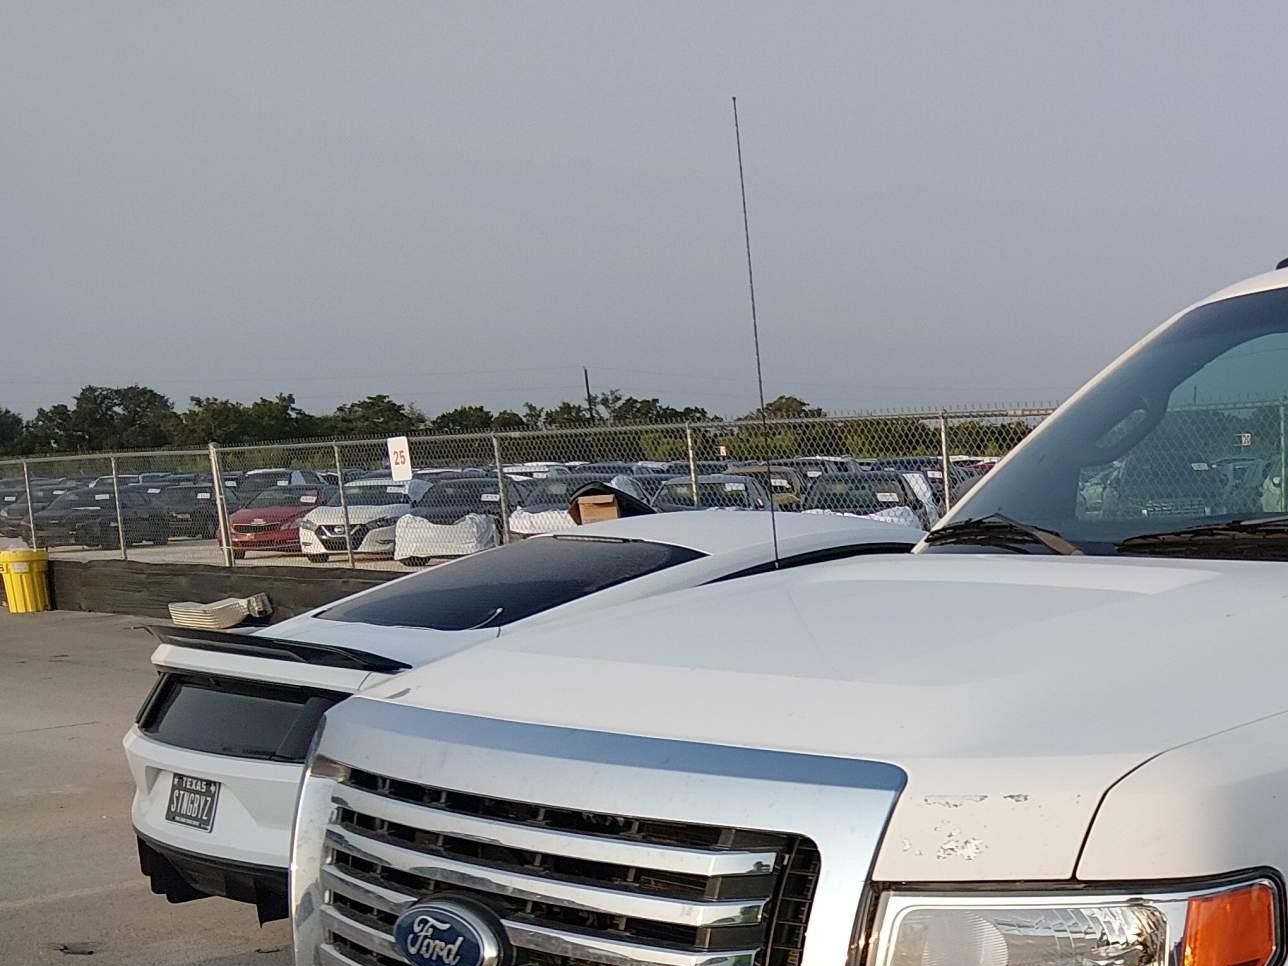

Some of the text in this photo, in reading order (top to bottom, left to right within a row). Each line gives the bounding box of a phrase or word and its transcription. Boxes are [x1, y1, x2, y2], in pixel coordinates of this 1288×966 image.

[393, 450, 406, 466] 25
[182, 776, 207, 792] TEXAS
[407, 915, 464, 966] Ford
